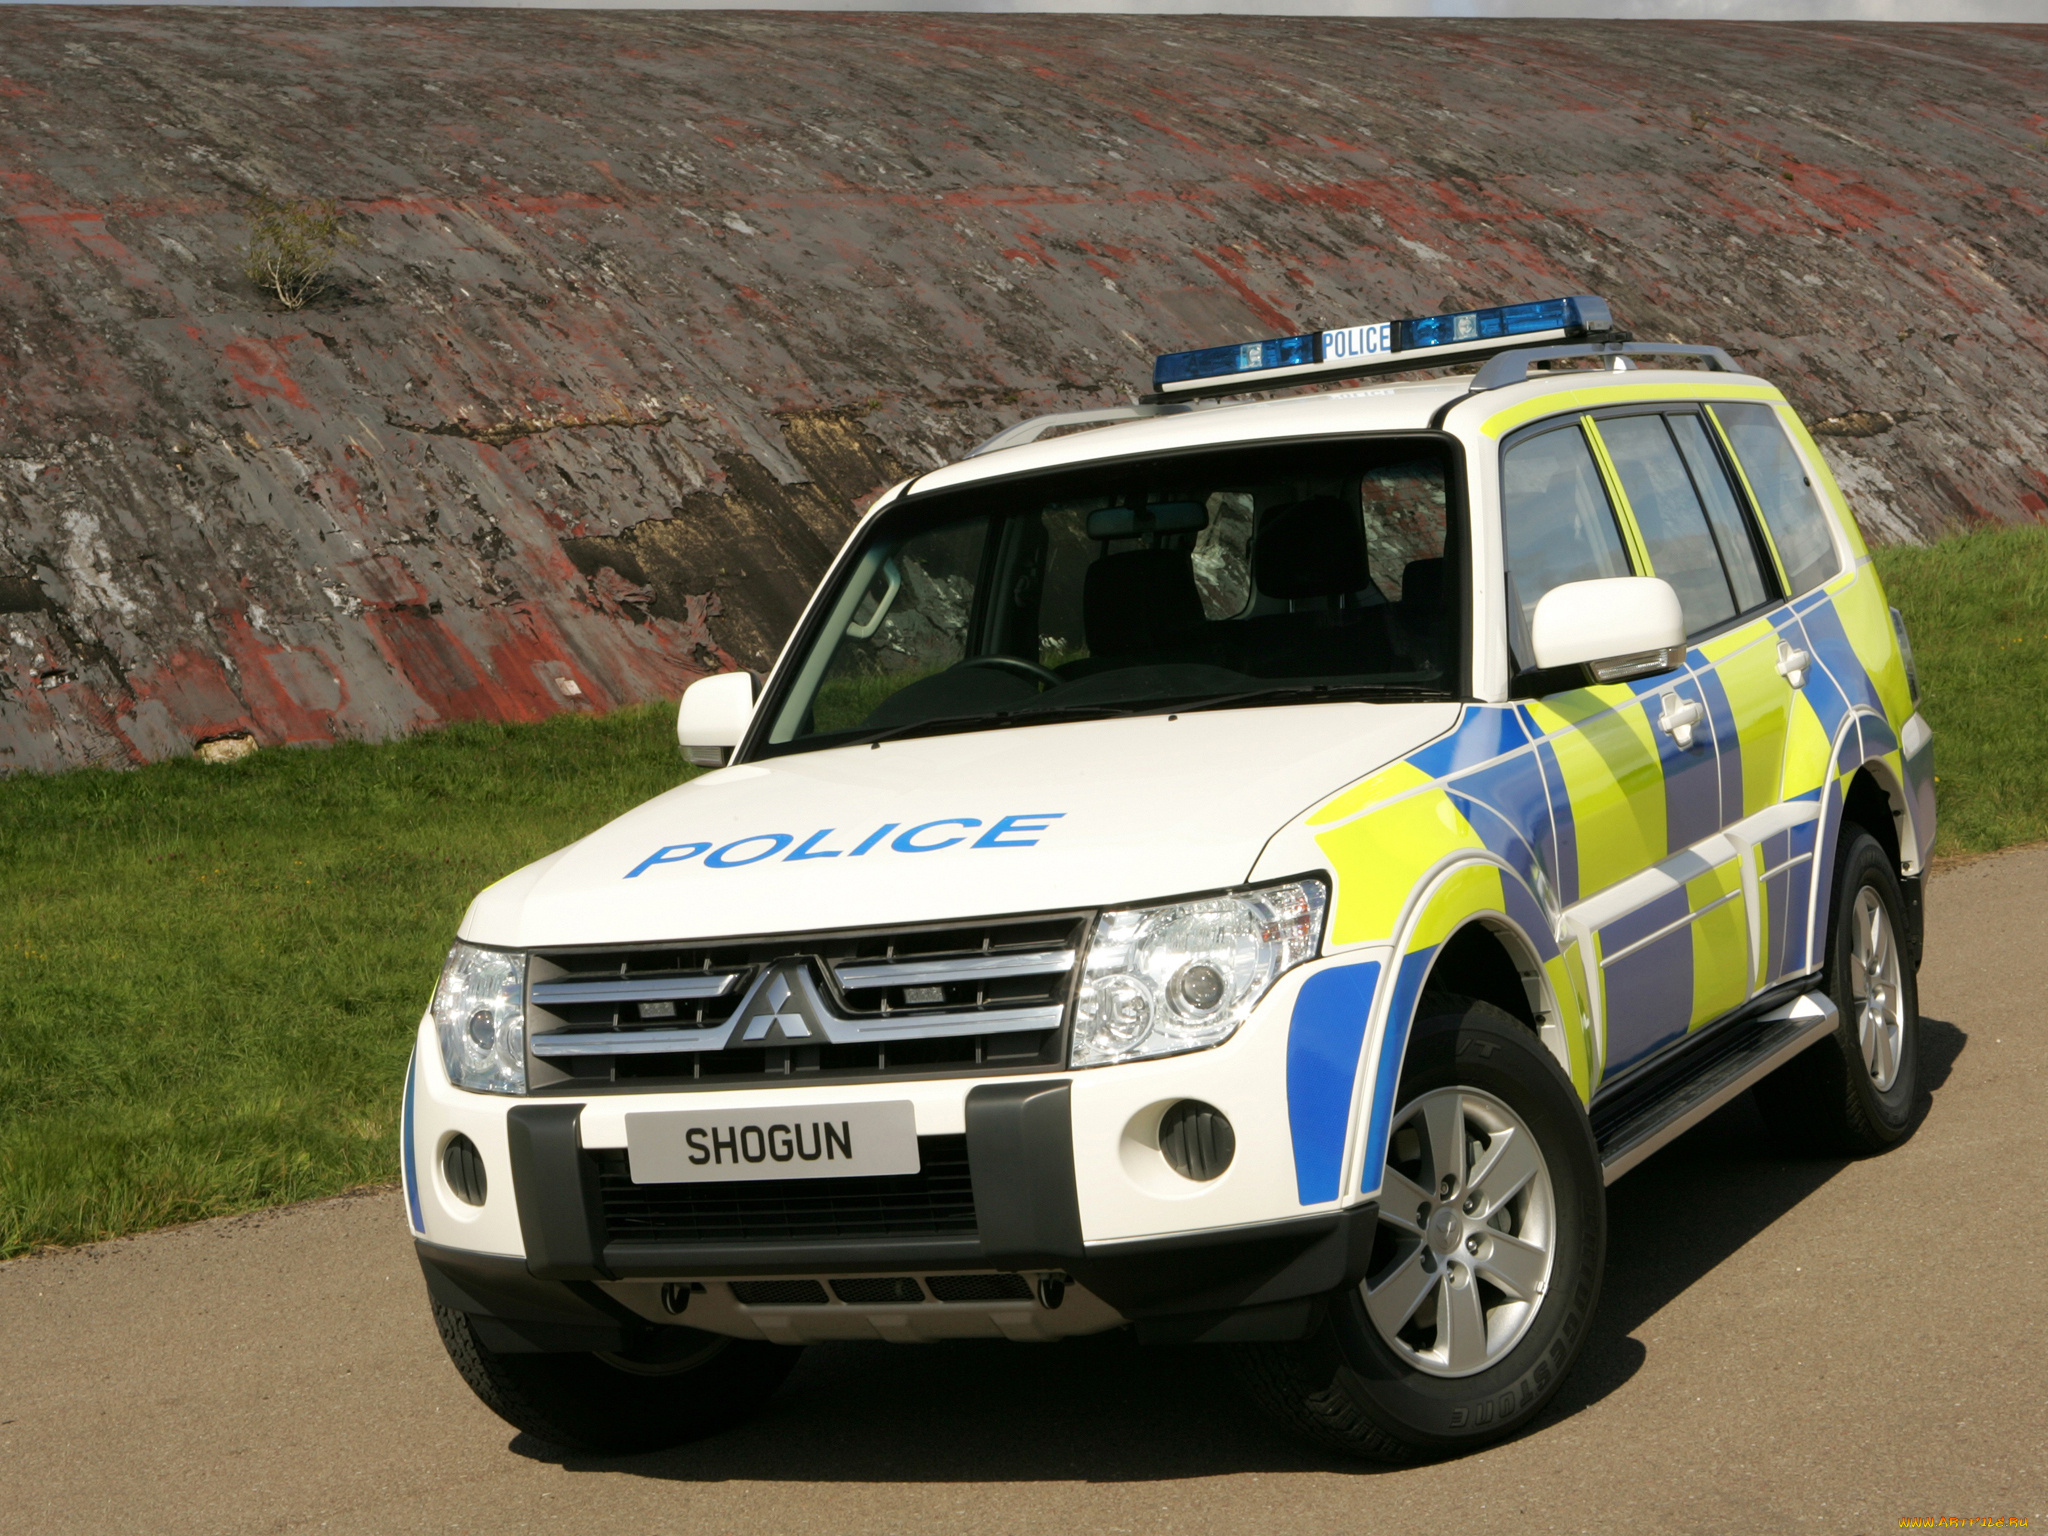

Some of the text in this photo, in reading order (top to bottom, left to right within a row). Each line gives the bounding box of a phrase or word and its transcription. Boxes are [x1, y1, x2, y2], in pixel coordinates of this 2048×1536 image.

[1322, 324, 1391, 360] POLICE
[622, 812, 1068, 879] POLICE
[685, 1120, 853, 1166] SHOGUN
